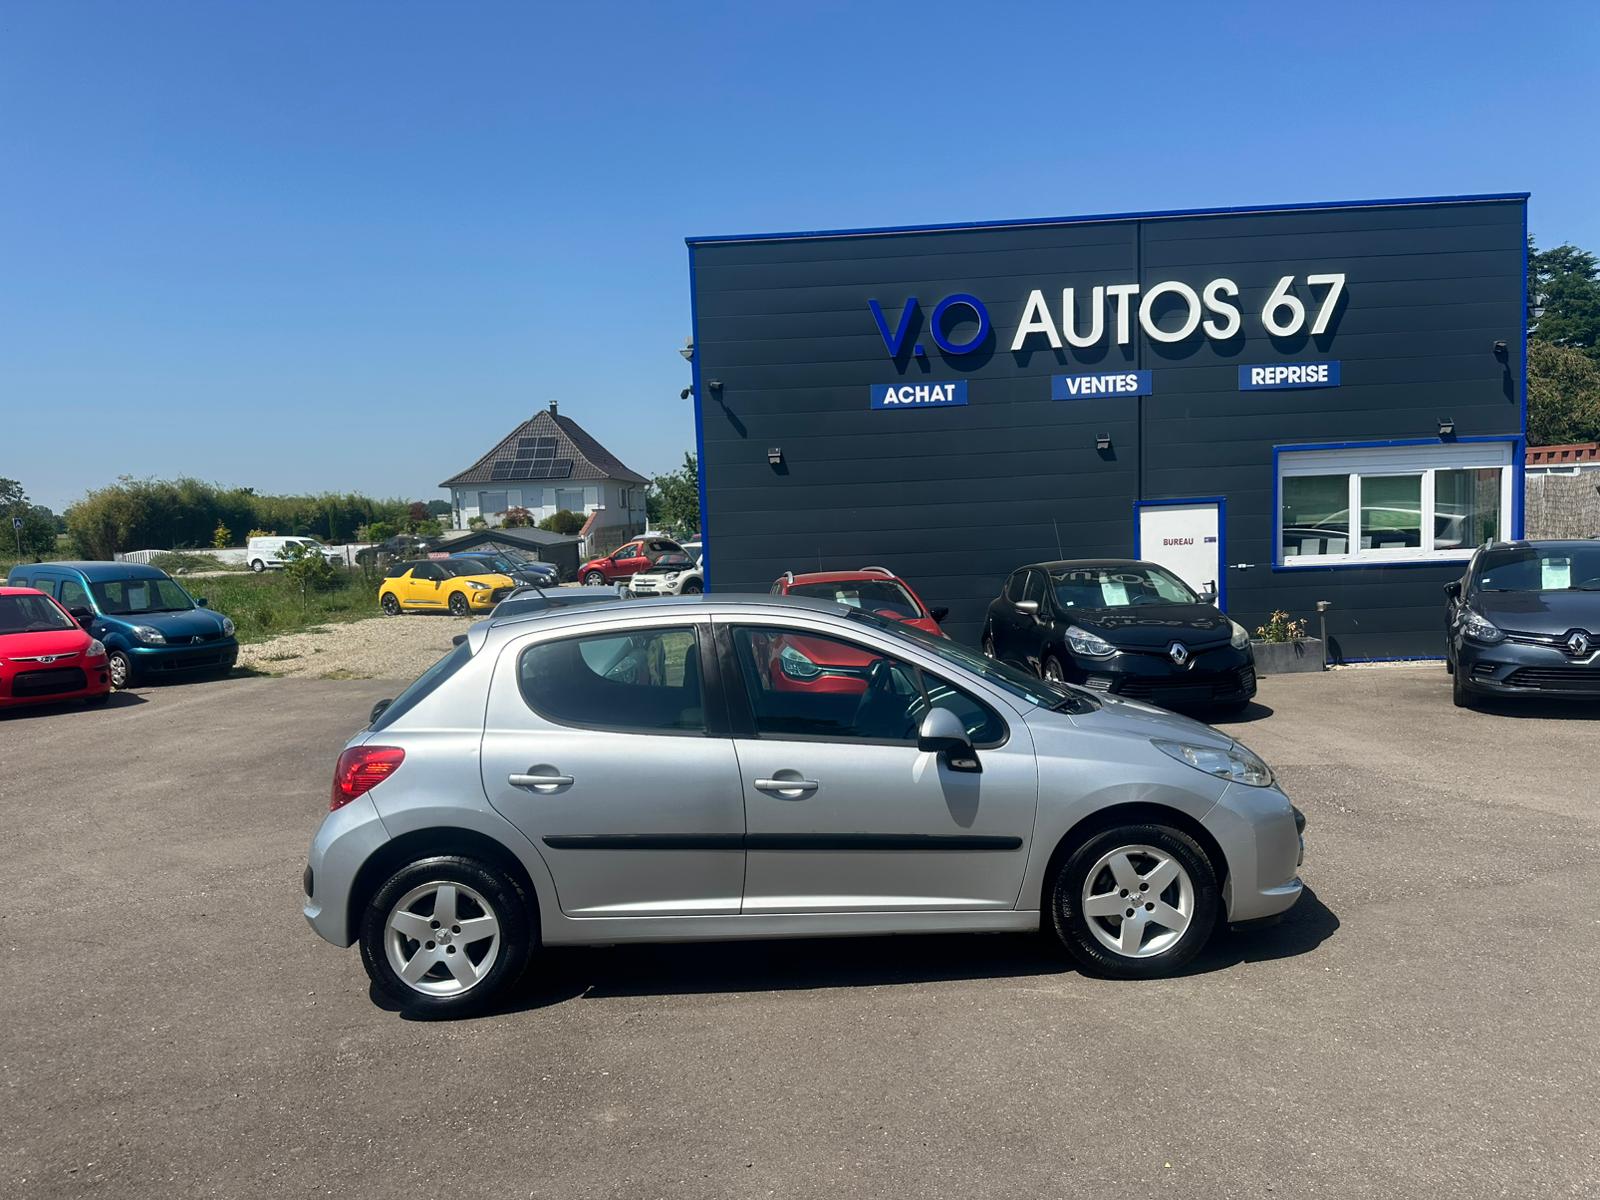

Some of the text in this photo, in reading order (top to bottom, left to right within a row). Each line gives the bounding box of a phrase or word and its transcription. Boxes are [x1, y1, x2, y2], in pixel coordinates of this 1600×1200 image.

[1010, 278, 1241, 351] AUTOS
[1262, 273, 1345, 337] 67
[1065, 374, 1138, 395] VENTES
[1251, 364, 1329, 385] REPRISE
[883, 384, 956, 405] ACHAT
[1163, 537, 1194, 546] BUREAU
